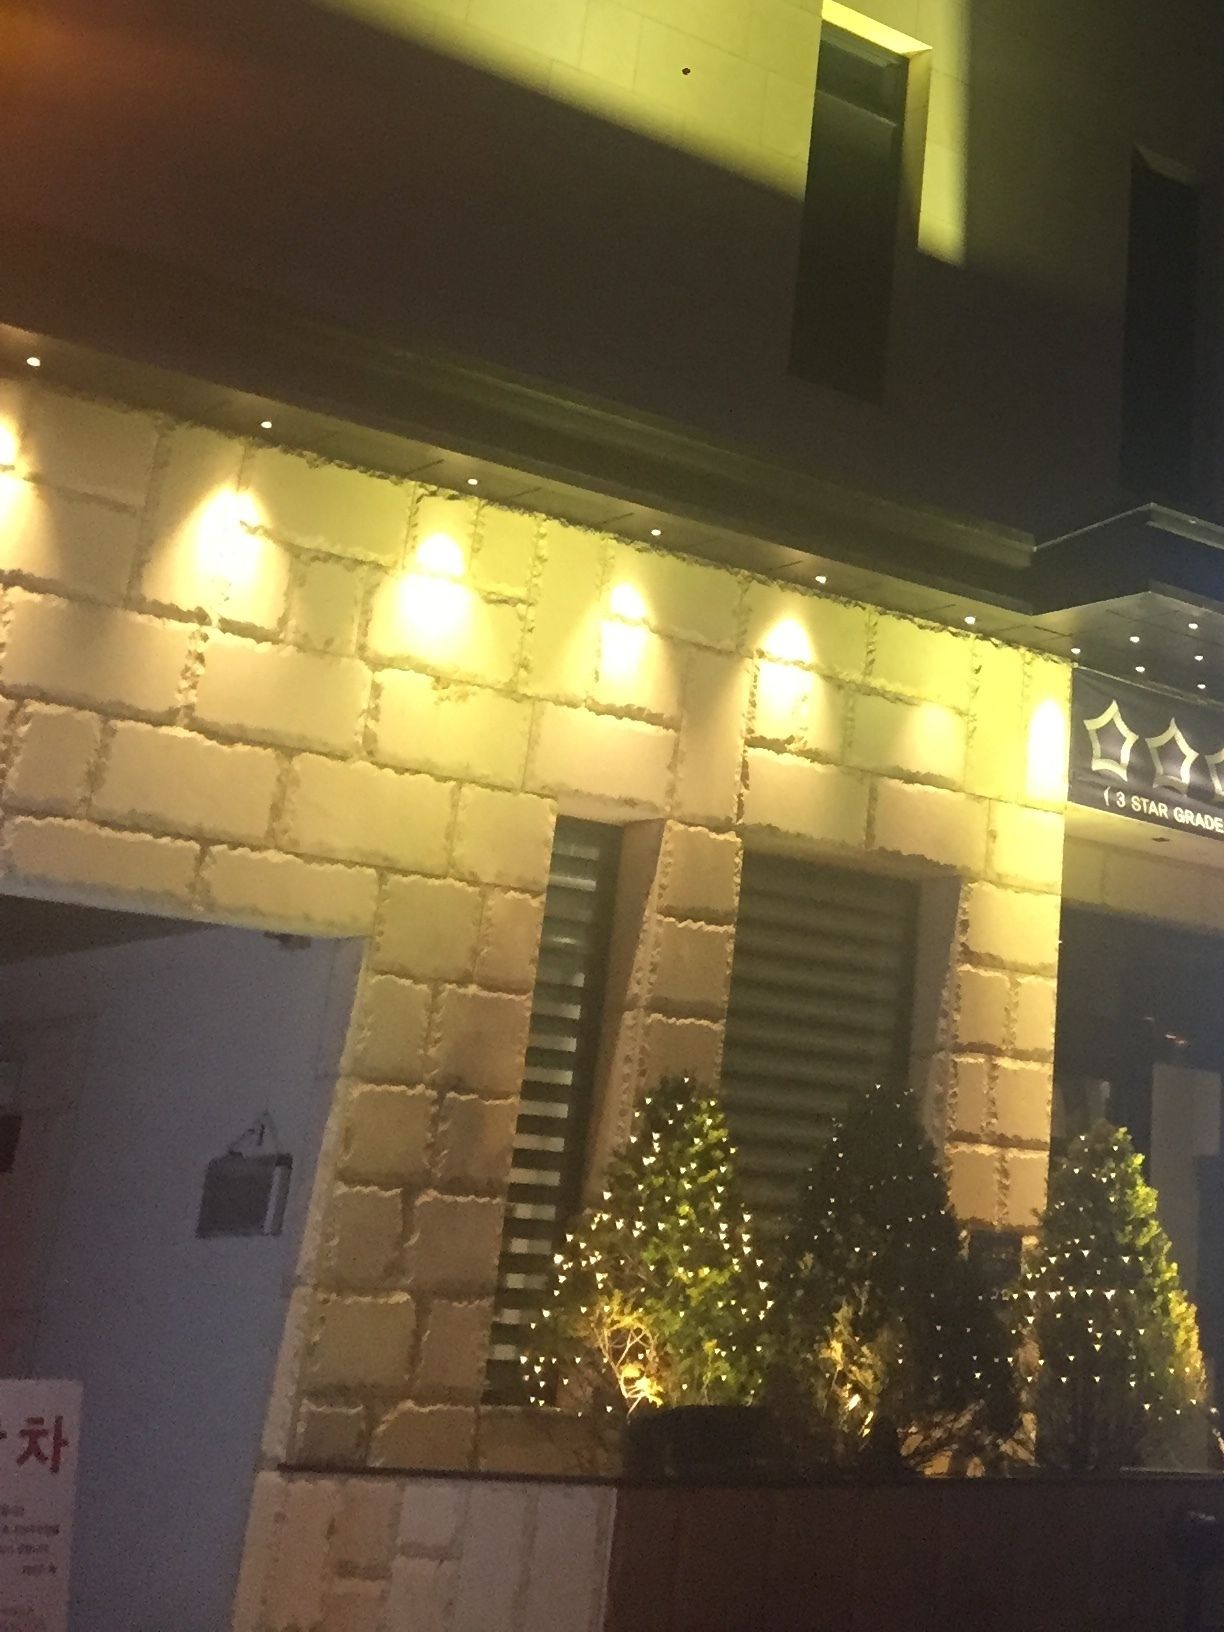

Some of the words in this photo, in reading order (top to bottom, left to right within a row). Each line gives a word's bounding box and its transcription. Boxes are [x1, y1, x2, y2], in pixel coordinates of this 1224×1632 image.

[1116, 791, 1126, 808] 3
[1131, 795, 1168, 819] STAR
[1173, 806, 1224, 835] GRADE
